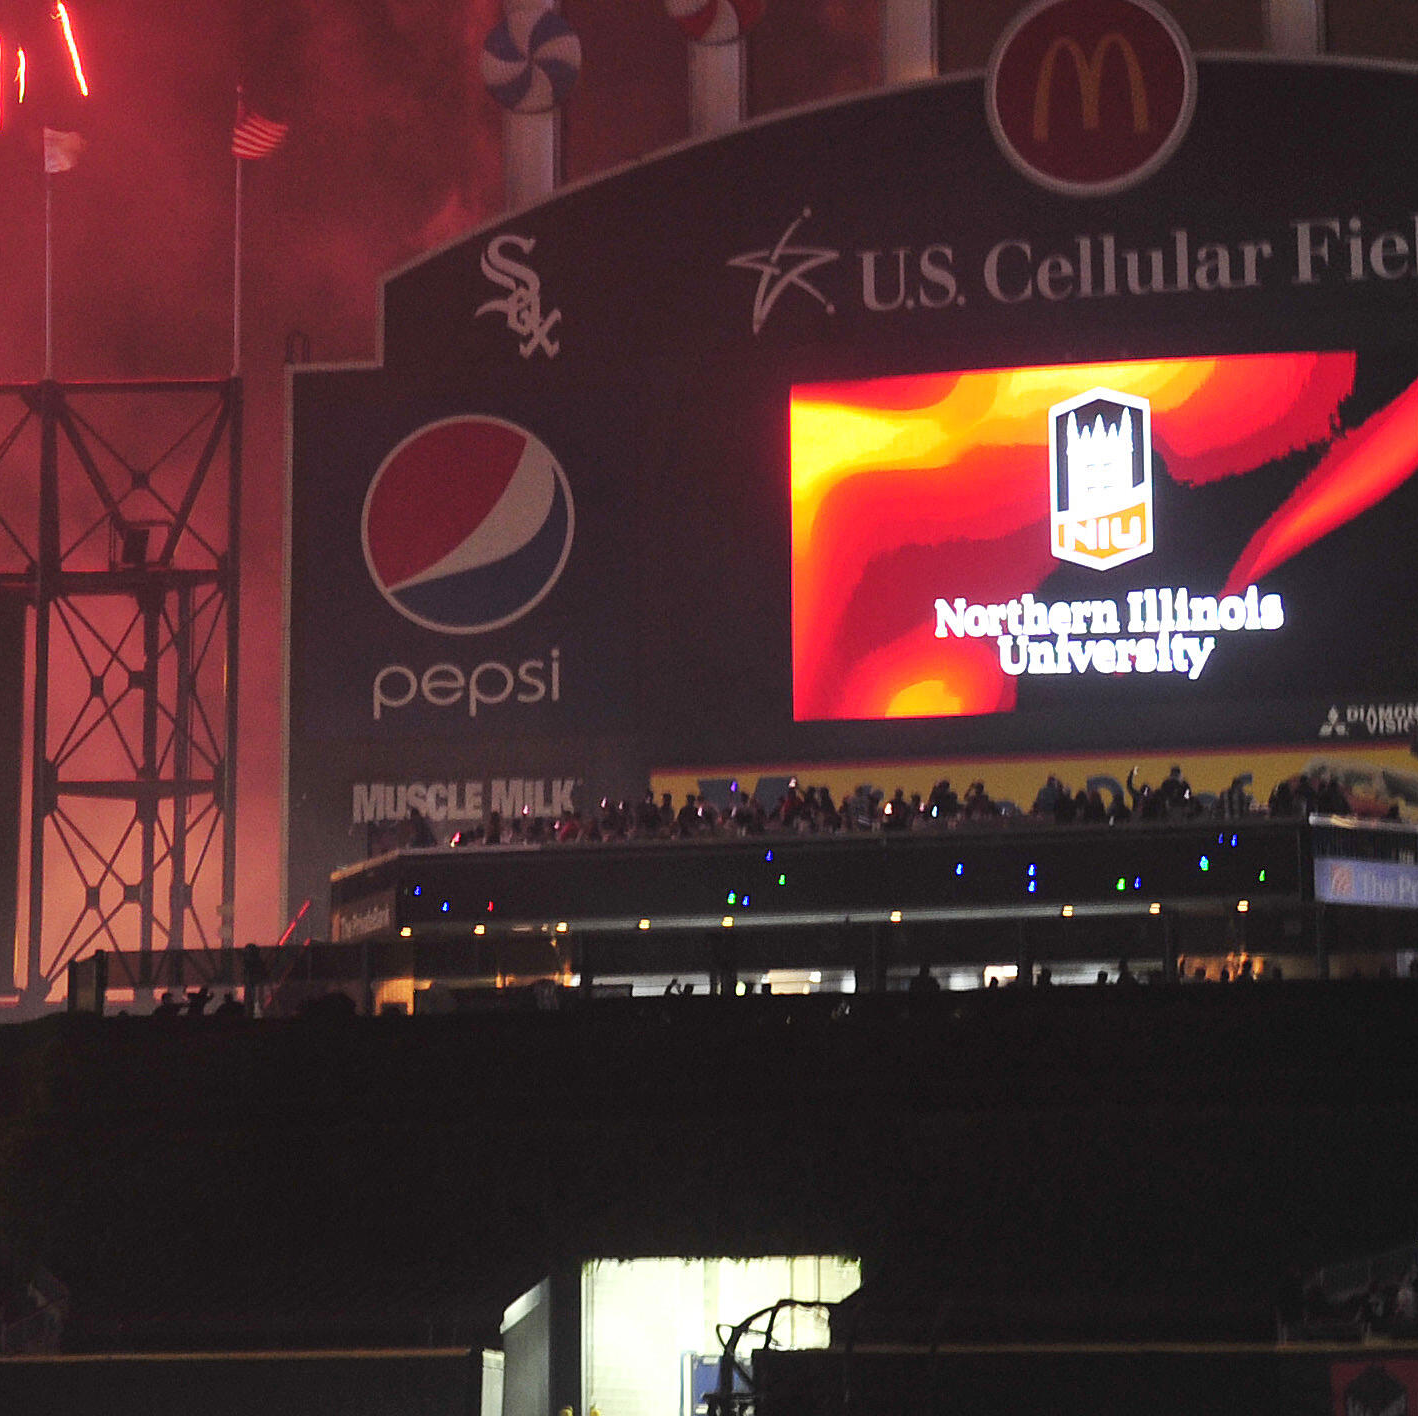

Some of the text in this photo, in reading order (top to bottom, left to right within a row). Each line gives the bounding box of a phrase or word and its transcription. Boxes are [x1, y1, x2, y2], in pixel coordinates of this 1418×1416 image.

[861, 244, 967, 311] U.S.
[983, 230, 1274, 302] Cellular
[474, 235, 563, 358] Sox
[1062, 512, 1145, 550] NIU
[934, 584, 1285, 637] Northern Illinois
[998, 631, 1216, 679] University
[373, 647, 560, 720] pepsi
[353, 777, 575, 824] MUSCLE MILK
[1361, 871, 1395, 898] The
